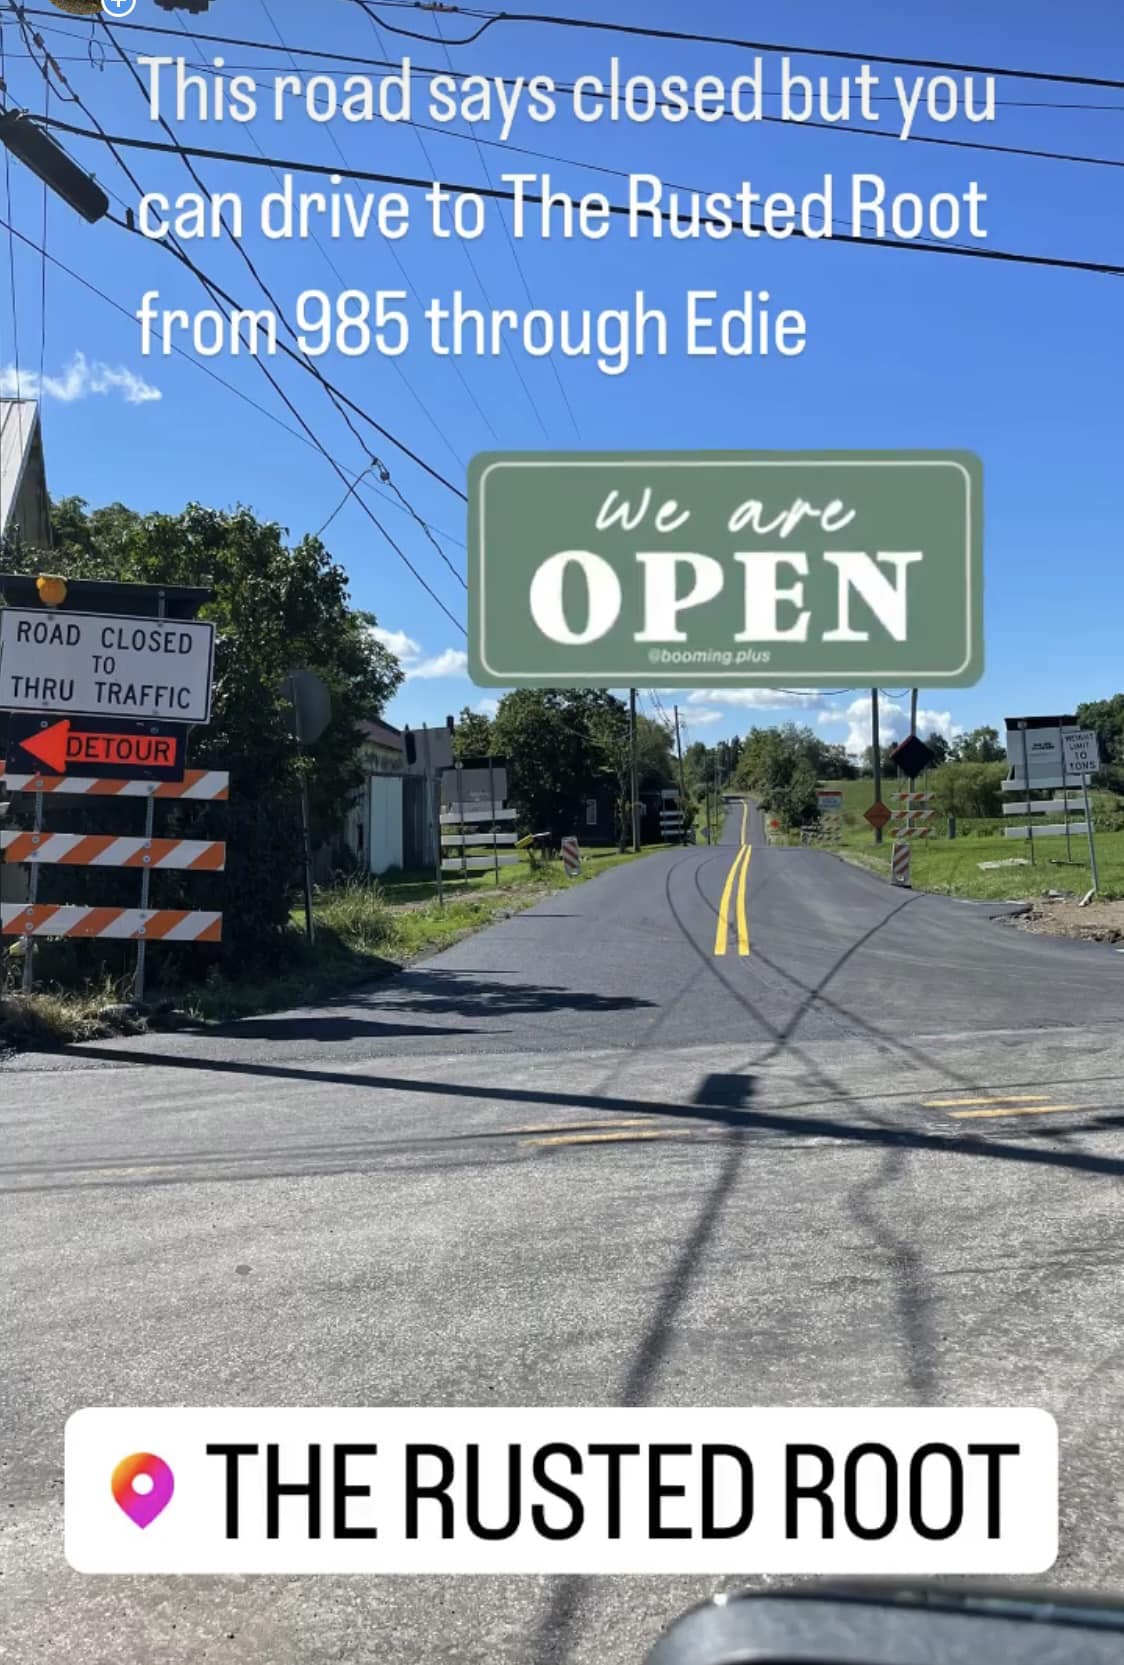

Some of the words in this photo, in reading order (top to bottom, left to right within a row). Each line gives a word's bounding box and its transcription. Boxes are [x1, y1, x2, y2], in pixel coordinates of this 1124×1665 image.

[17, 621, 81, 646] ROAD
[101, 627, 192, 654] CLOSED
[92, 655, 115, 675] TO
[11, 675, 74, 701] THRU
[95, 681, 191, 709] TRAFFIC
[67, 736, 170, 761] DETOUR
[1070, 742, 1089, 750] LIMIT
[1075, 751, 1087, 760] 10
[1069, 761, 1096, 770] TONS
